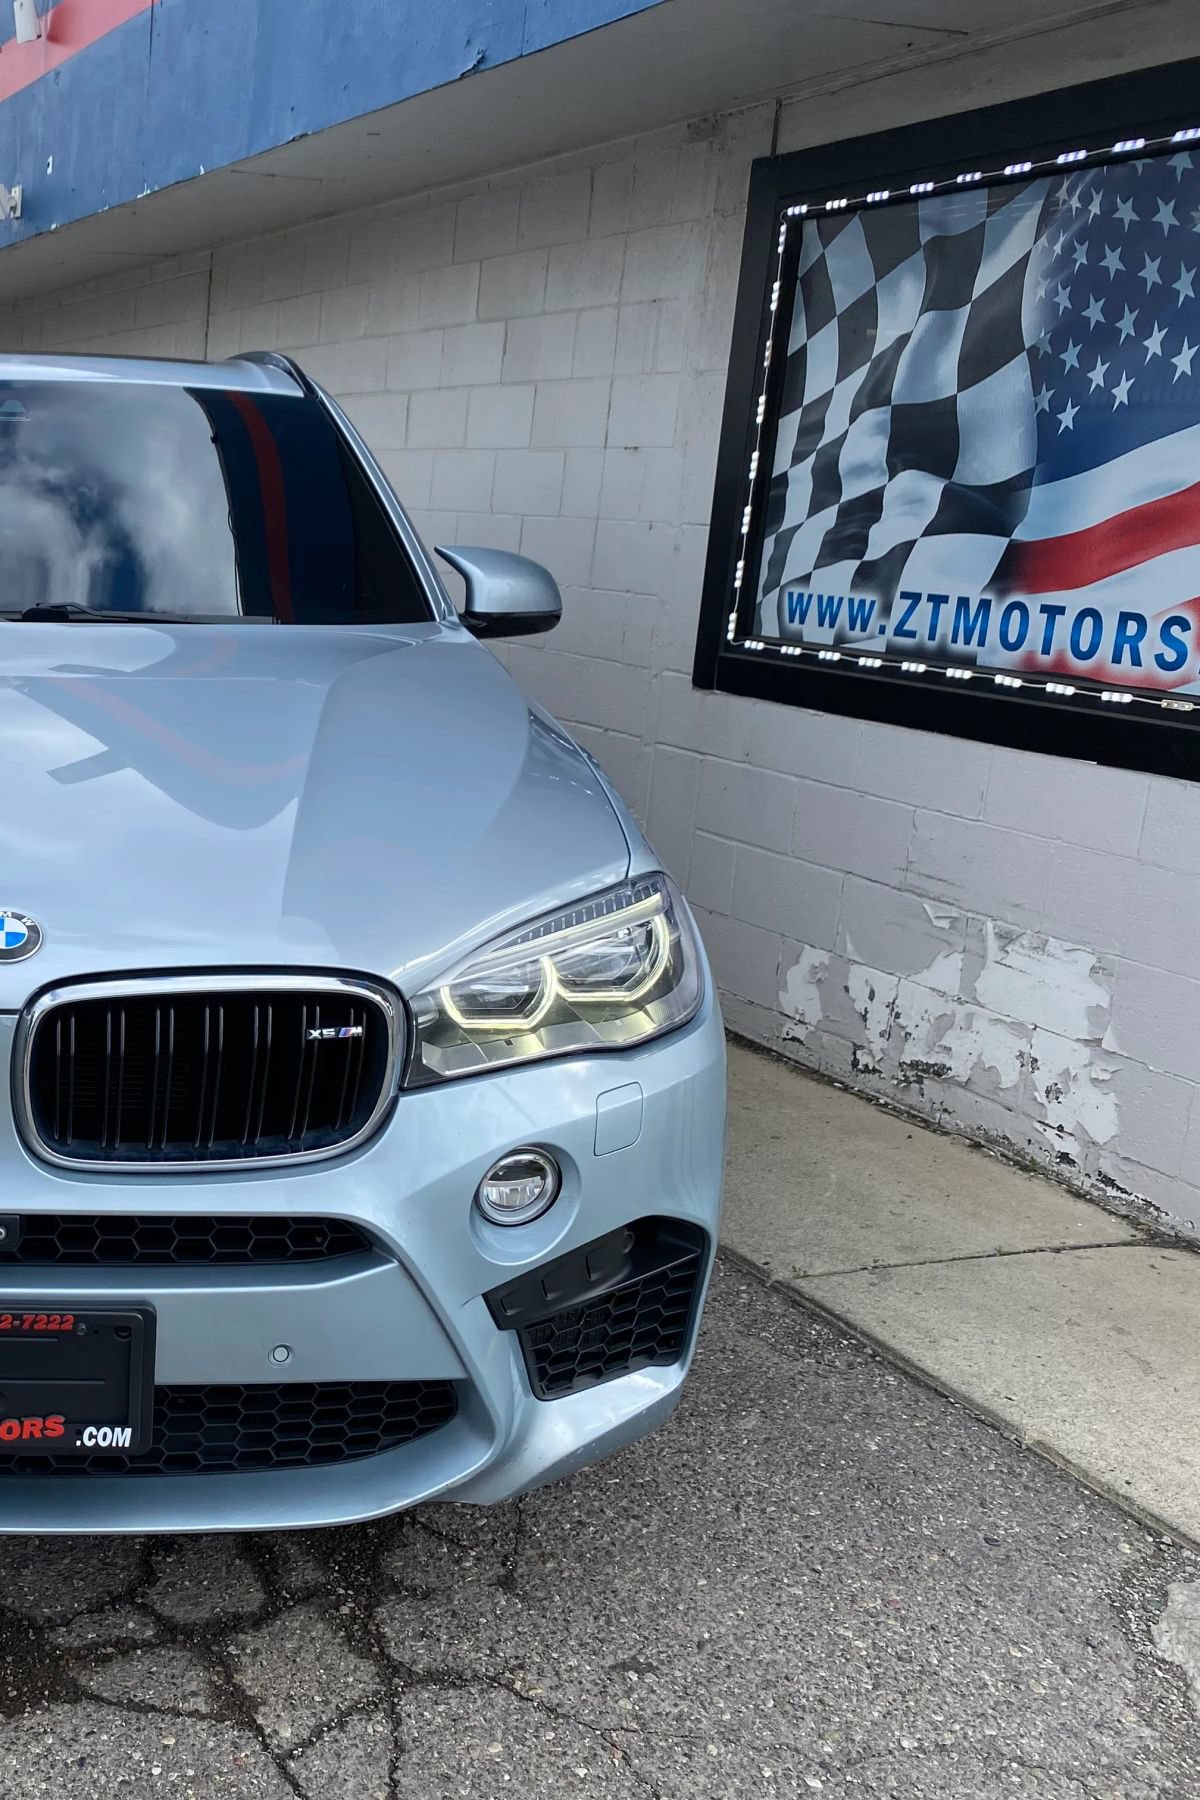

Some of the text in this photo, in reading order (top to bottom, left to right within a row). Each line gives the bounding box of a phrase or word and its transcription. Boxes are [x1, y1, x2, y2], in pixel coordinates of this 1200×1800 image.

[786, 591, 1200, 674] WWW.ZTMOTORS
[307, 1028, 336, 1040] X5
[75, 1426, 132, 1447] .COM
